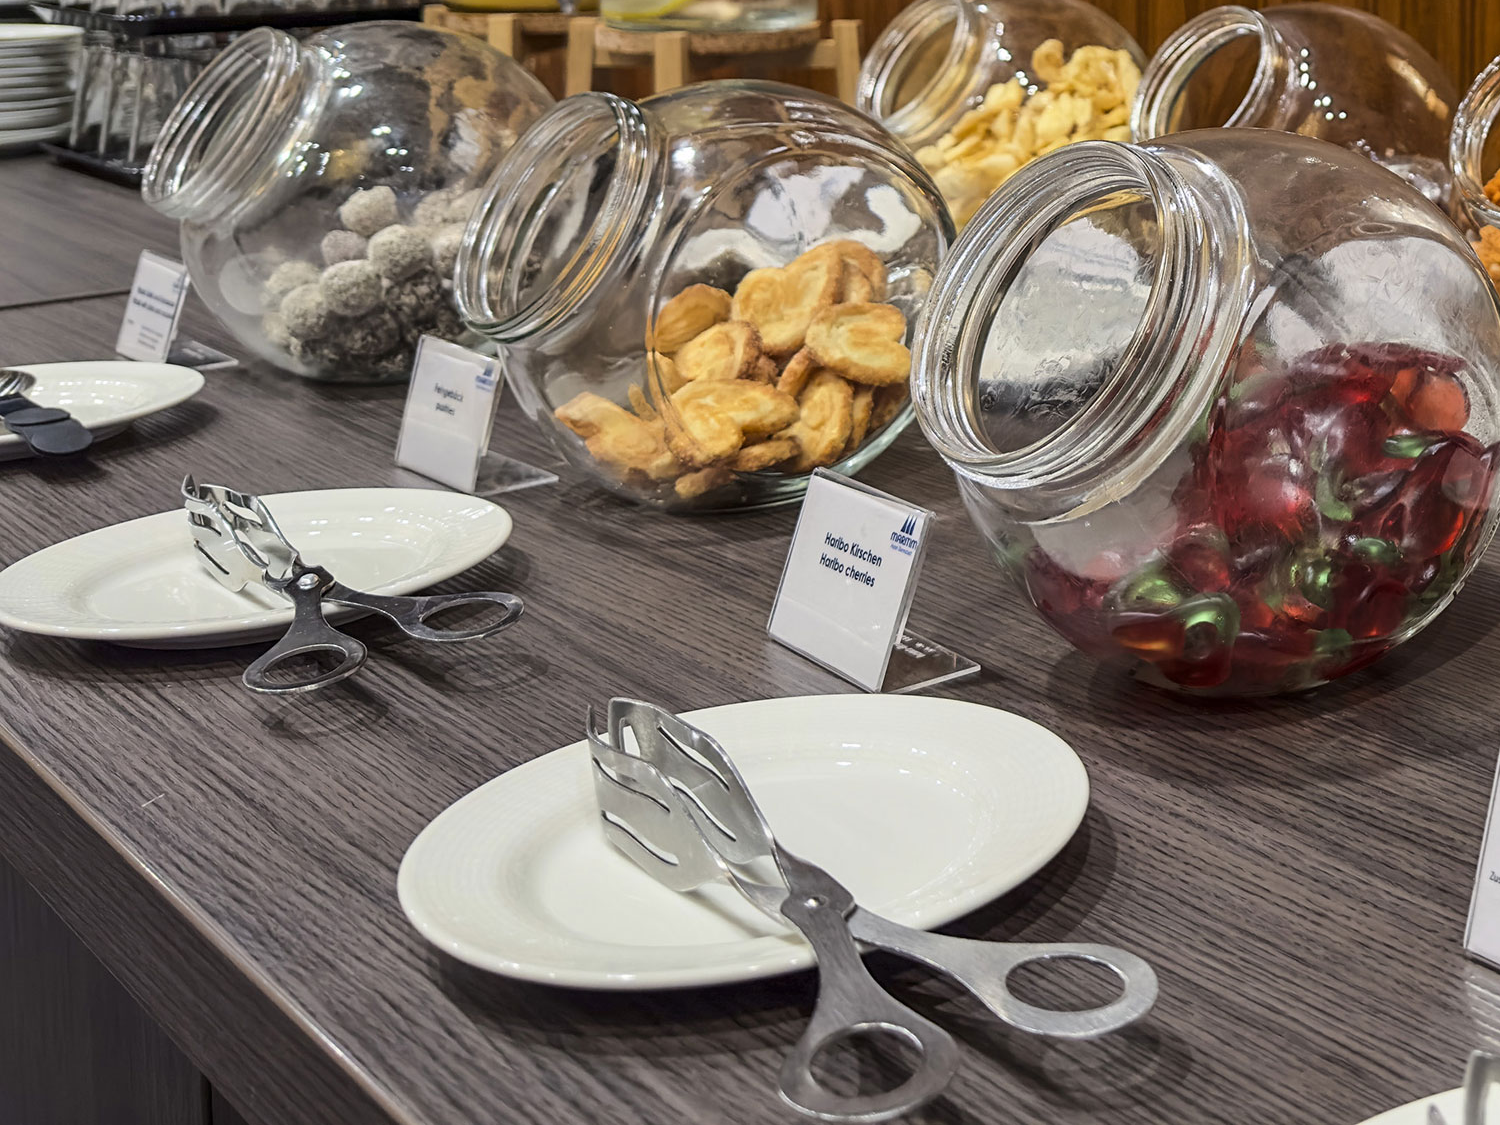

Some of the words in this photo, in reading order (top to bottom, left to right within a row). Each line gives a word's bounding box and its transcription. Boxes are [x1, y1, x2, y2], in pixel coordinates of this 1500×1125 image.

[824, 532, 849, 553] Haribo
[850, 542, 883, 567] Kirschen
[819, 553, 845, 574] Haribo
[845, 565, 876, 588] cherries
